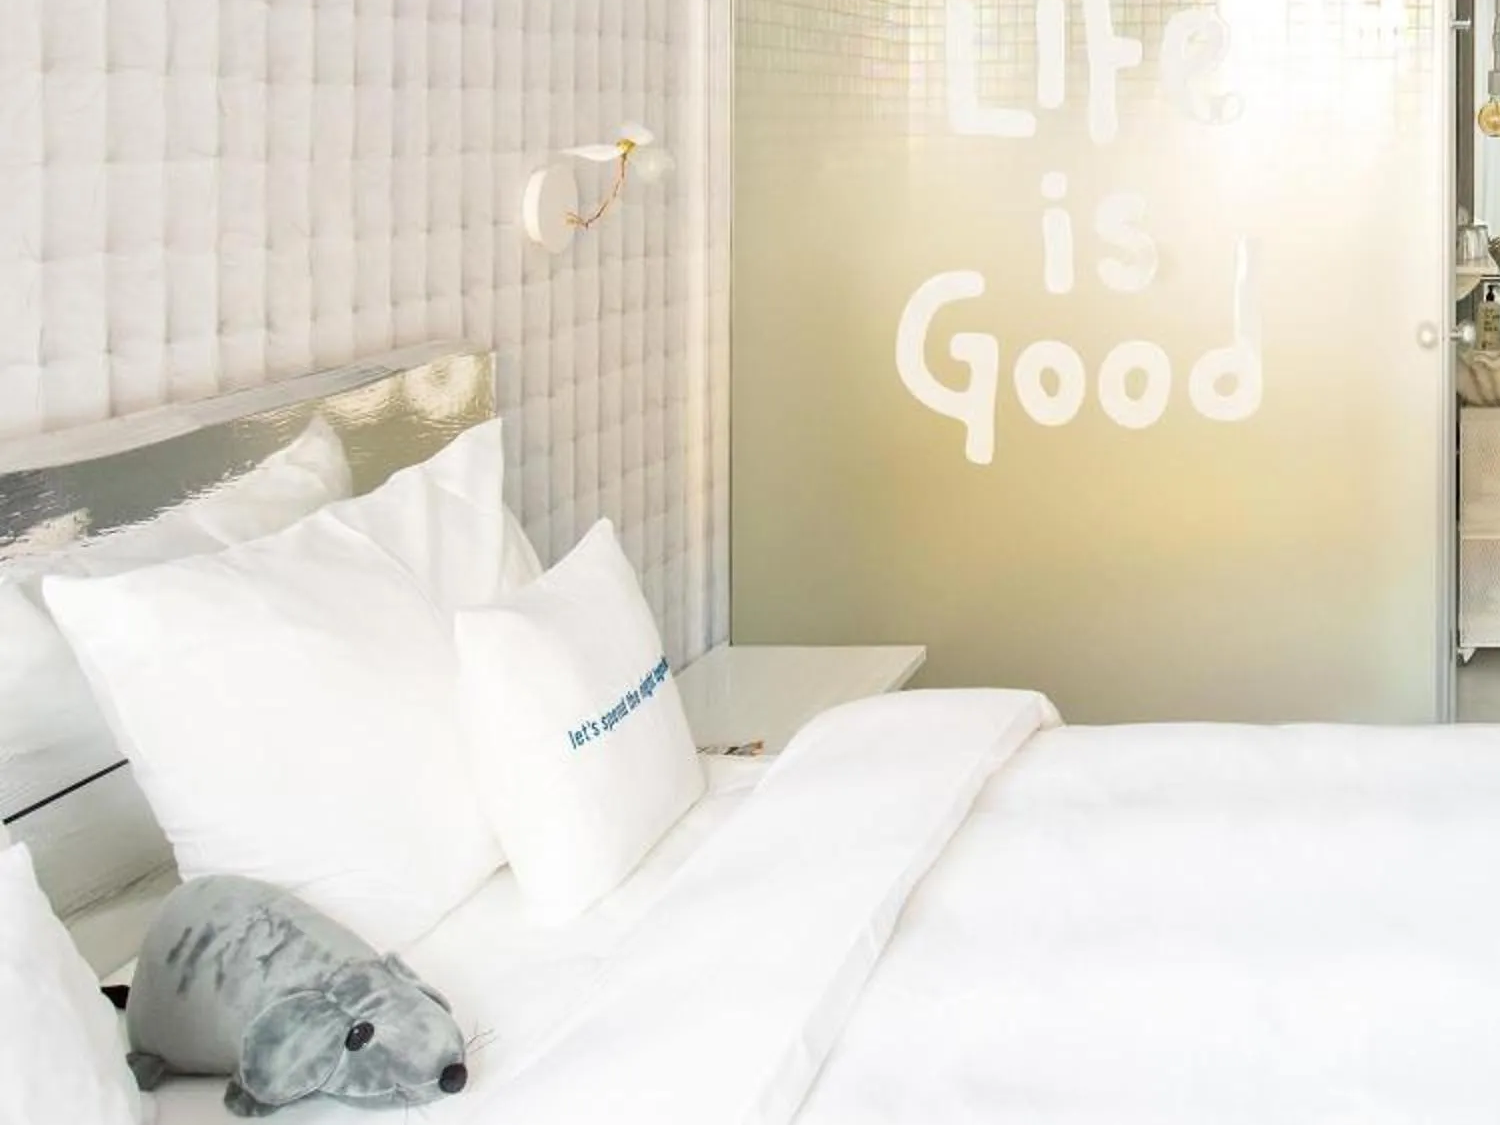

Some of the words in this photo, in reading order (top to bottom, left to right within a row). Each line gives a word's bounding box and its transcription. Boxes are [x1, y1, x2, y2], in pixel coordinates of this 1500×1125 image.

[1041, 171, 1159, 293] is
[895, 231, 1263, 465] Good
[567, 721, 601, 750] let's
[601, 696, 629, 731] spend
[626, 690, 641, 710] the
